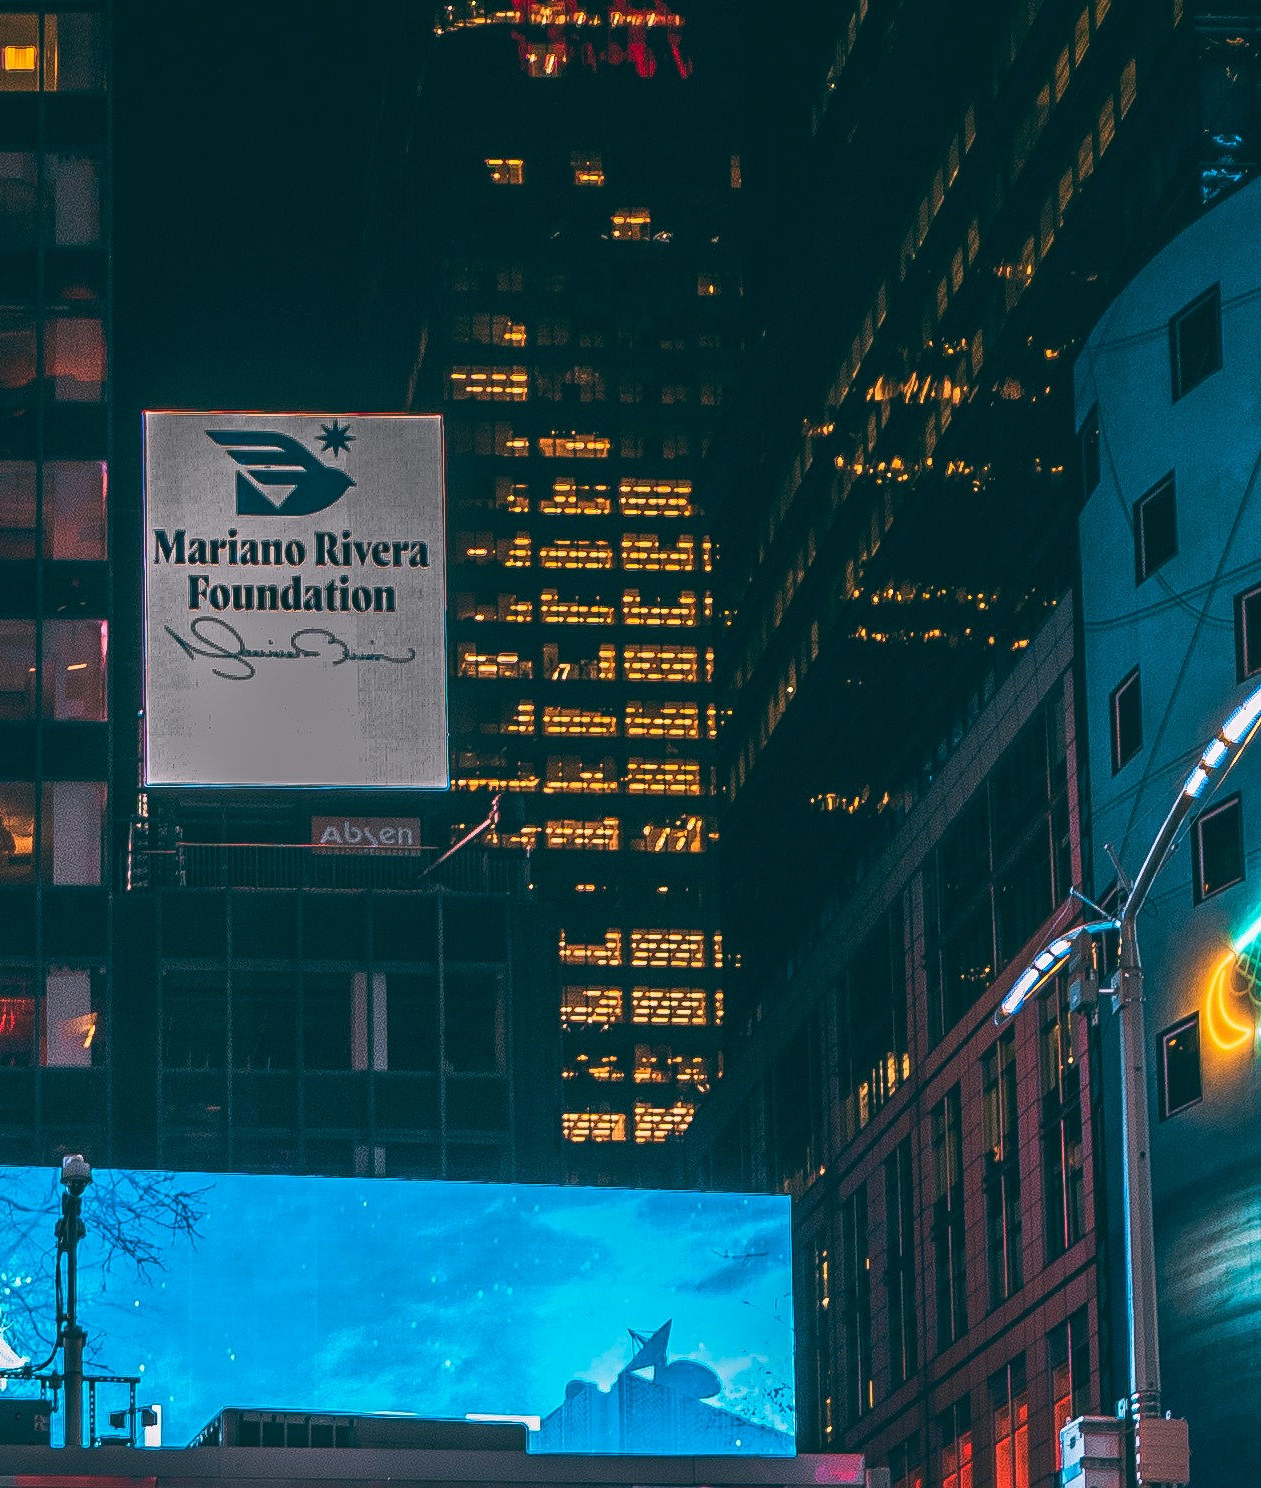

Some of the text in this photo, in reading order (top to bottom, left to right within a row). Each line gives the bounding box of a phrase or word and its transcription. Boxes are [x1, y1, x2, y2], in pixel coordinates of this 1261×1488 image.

[153, 528, 430, 568] Mariano Rivera
[188, 574, 397, 613] Foundation
